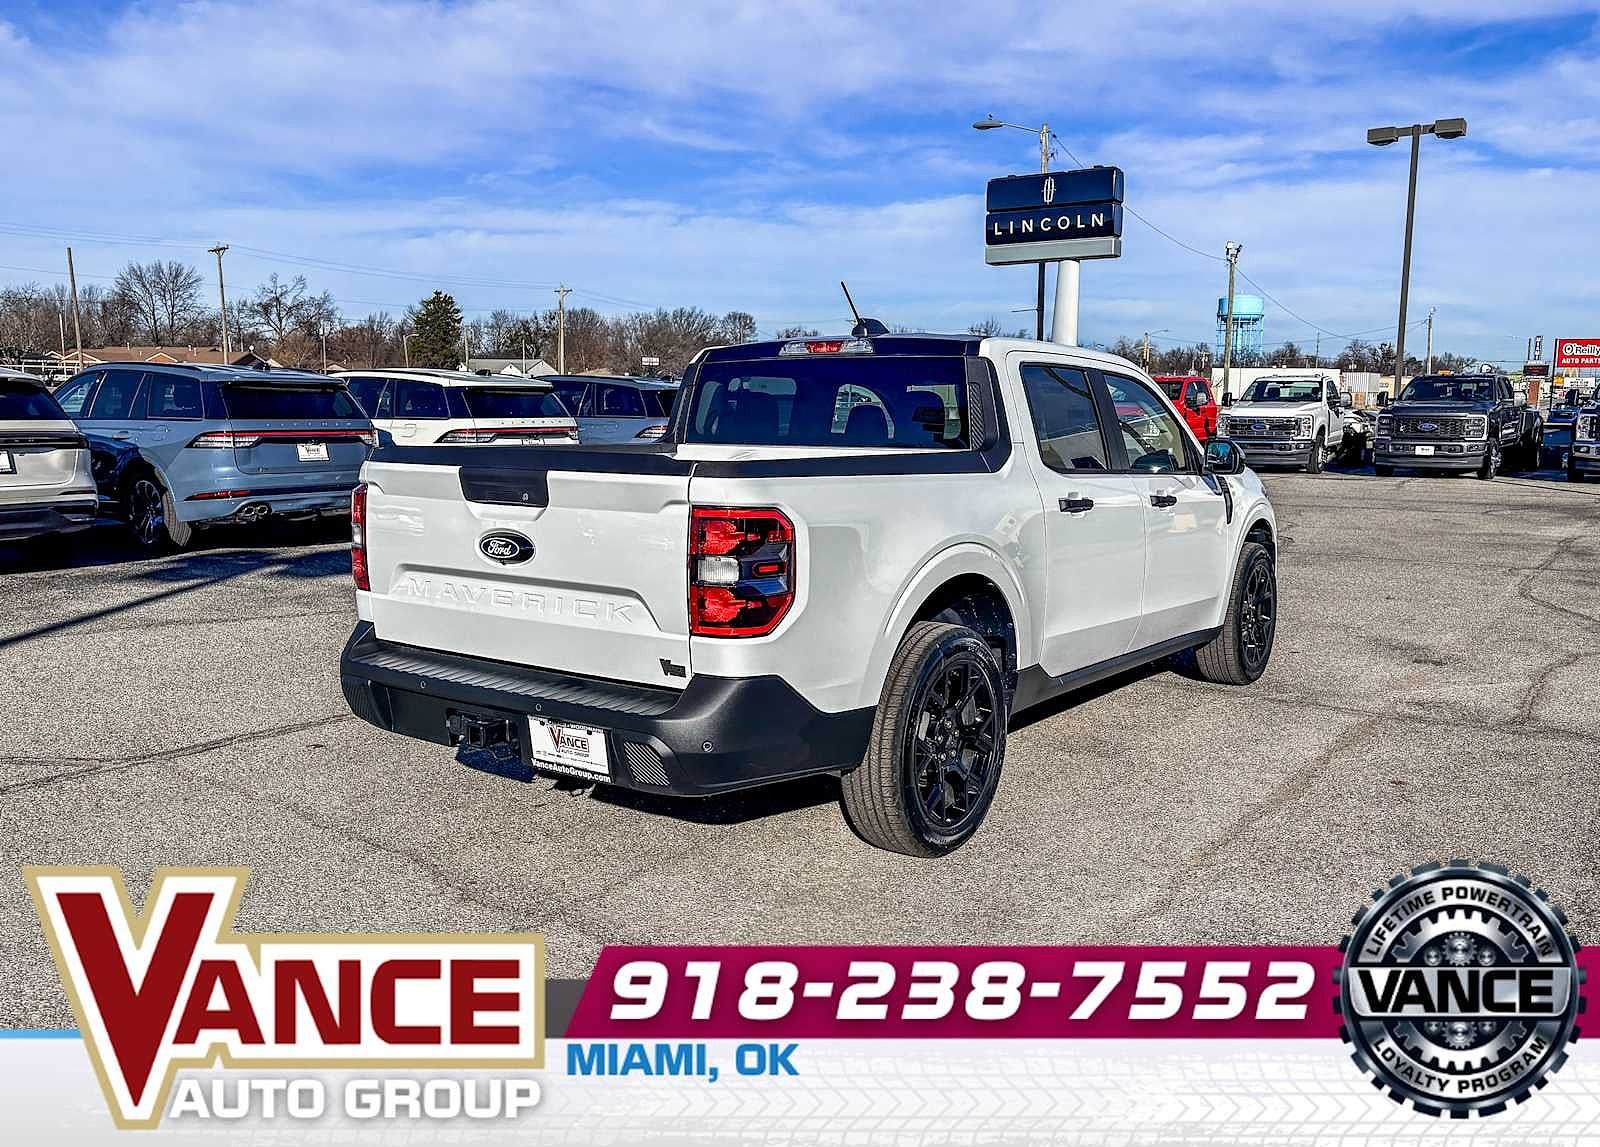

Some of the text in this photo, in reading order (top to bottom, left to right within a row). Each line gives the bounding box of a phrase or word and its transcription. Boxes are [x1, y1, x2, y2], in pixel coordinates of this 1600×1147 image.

[994, 213, 1104, 236] LINCOLN
[486, 539, 513, 556] Ford
[405, 576, 634, 625] MAVERICK
[549, 726, 588, 750] VANCE
[531, 758, 611, 783] VanceAutoGroup.com
